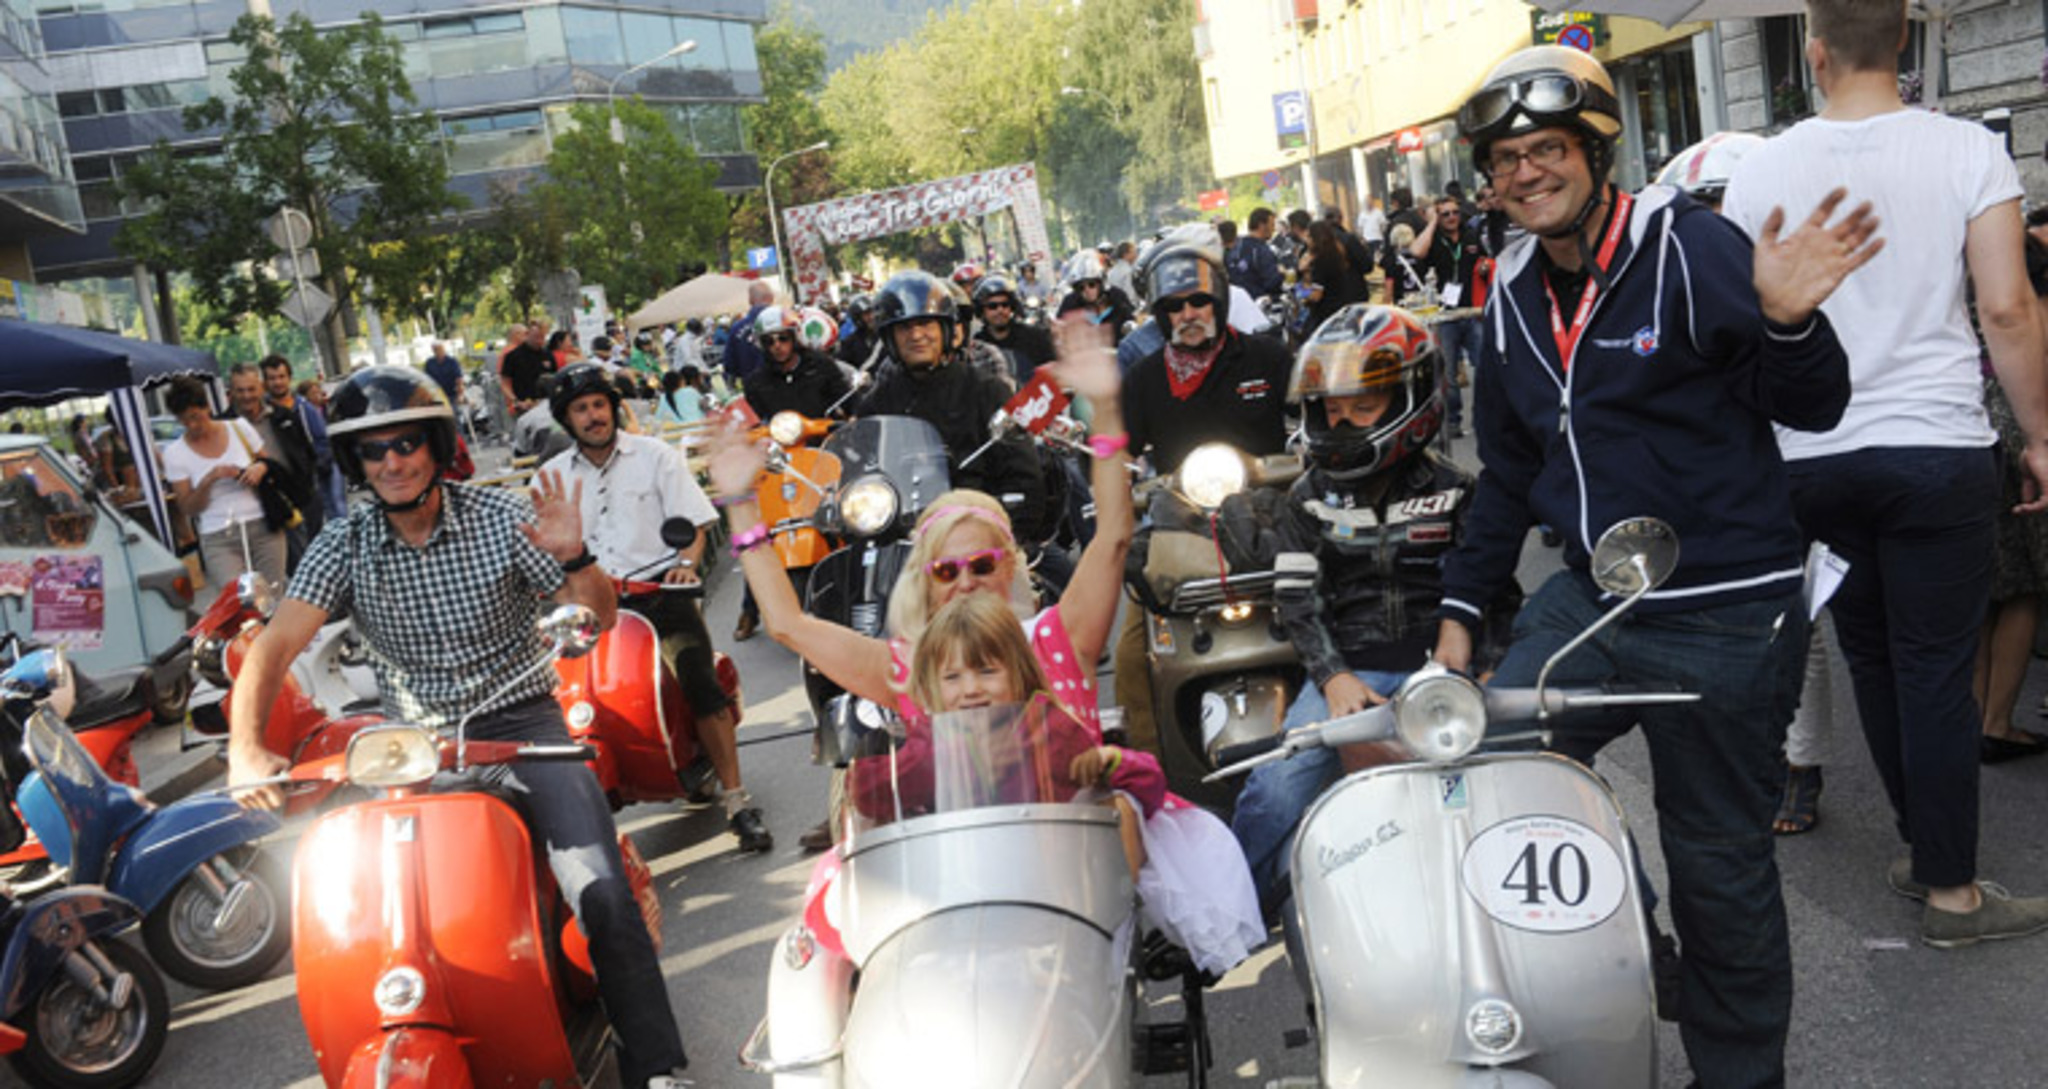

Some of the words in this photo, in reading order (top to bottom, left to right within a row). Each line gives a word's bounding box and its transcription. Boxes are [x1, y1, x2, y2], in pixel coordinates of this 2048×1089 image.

[1283, 102, 1302, 127] P
[882, 199, 920, 230] Tre
[756, 247, 769, 267] P
[1501, 842, 1590, 907] 40
